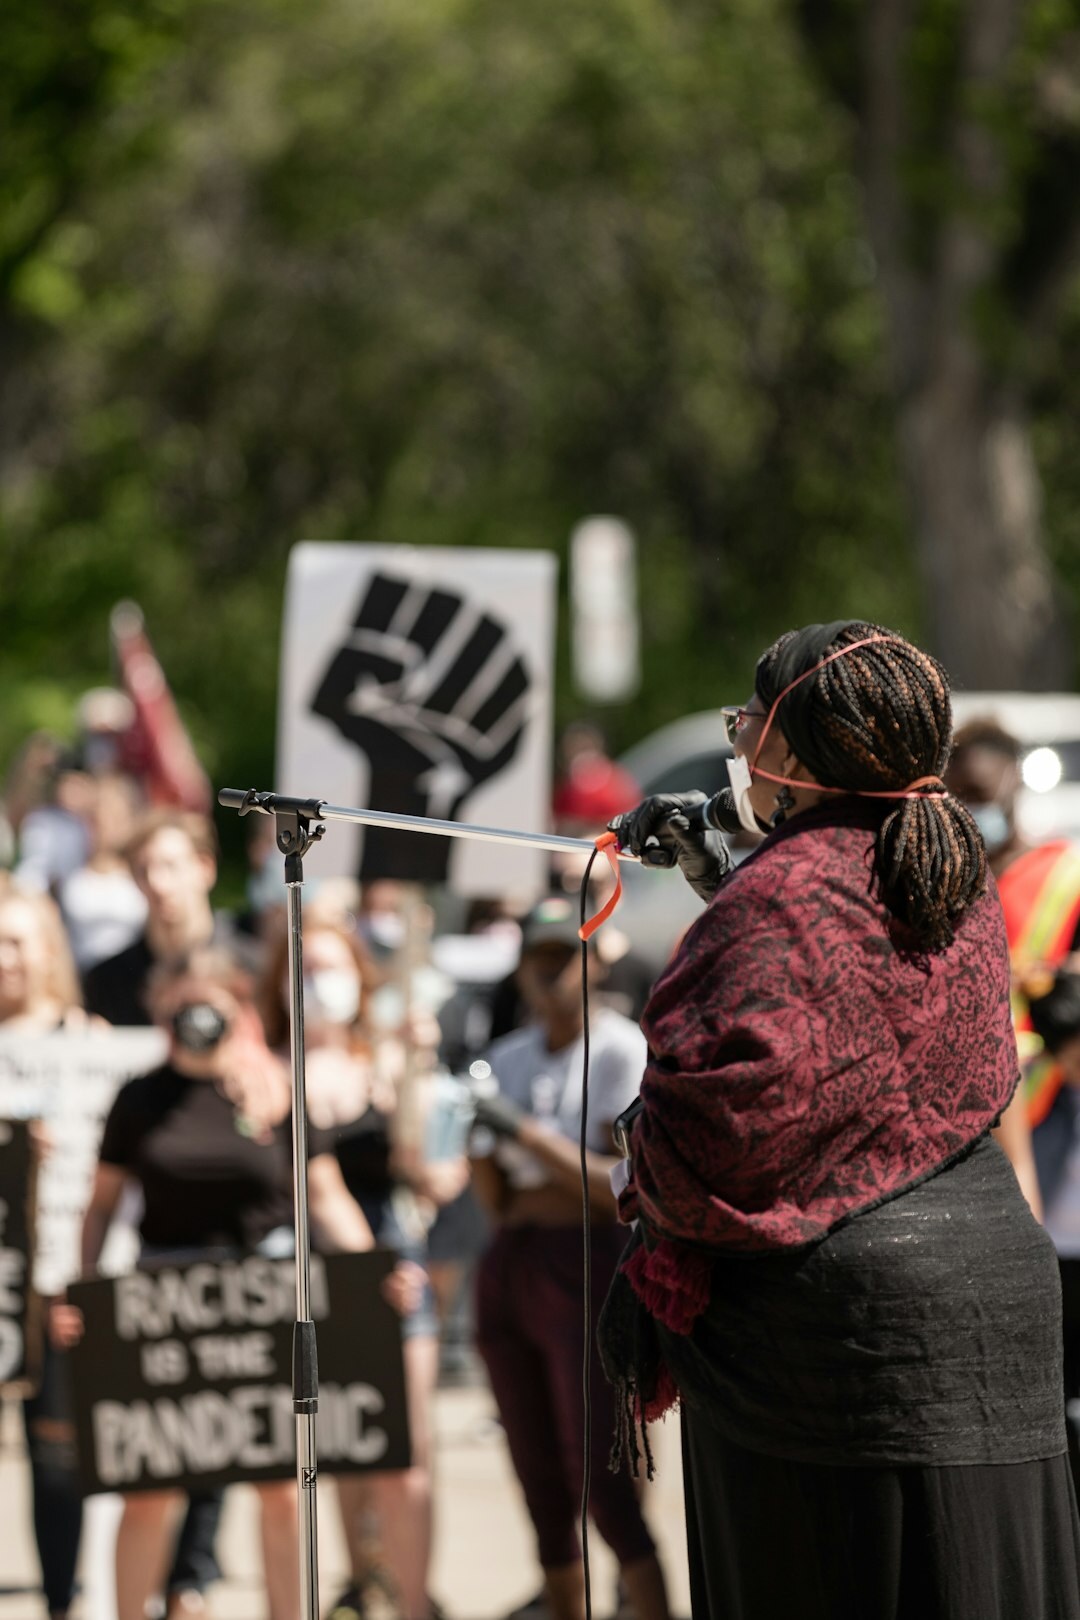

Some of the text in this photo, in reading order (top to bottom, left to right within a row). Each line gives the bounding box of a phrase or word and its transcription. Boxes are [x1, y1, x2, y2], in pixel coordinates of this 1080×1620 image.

[115, 1255, 331, 1340] RACISM
[141, 1331, 277, 1385] IS THE
